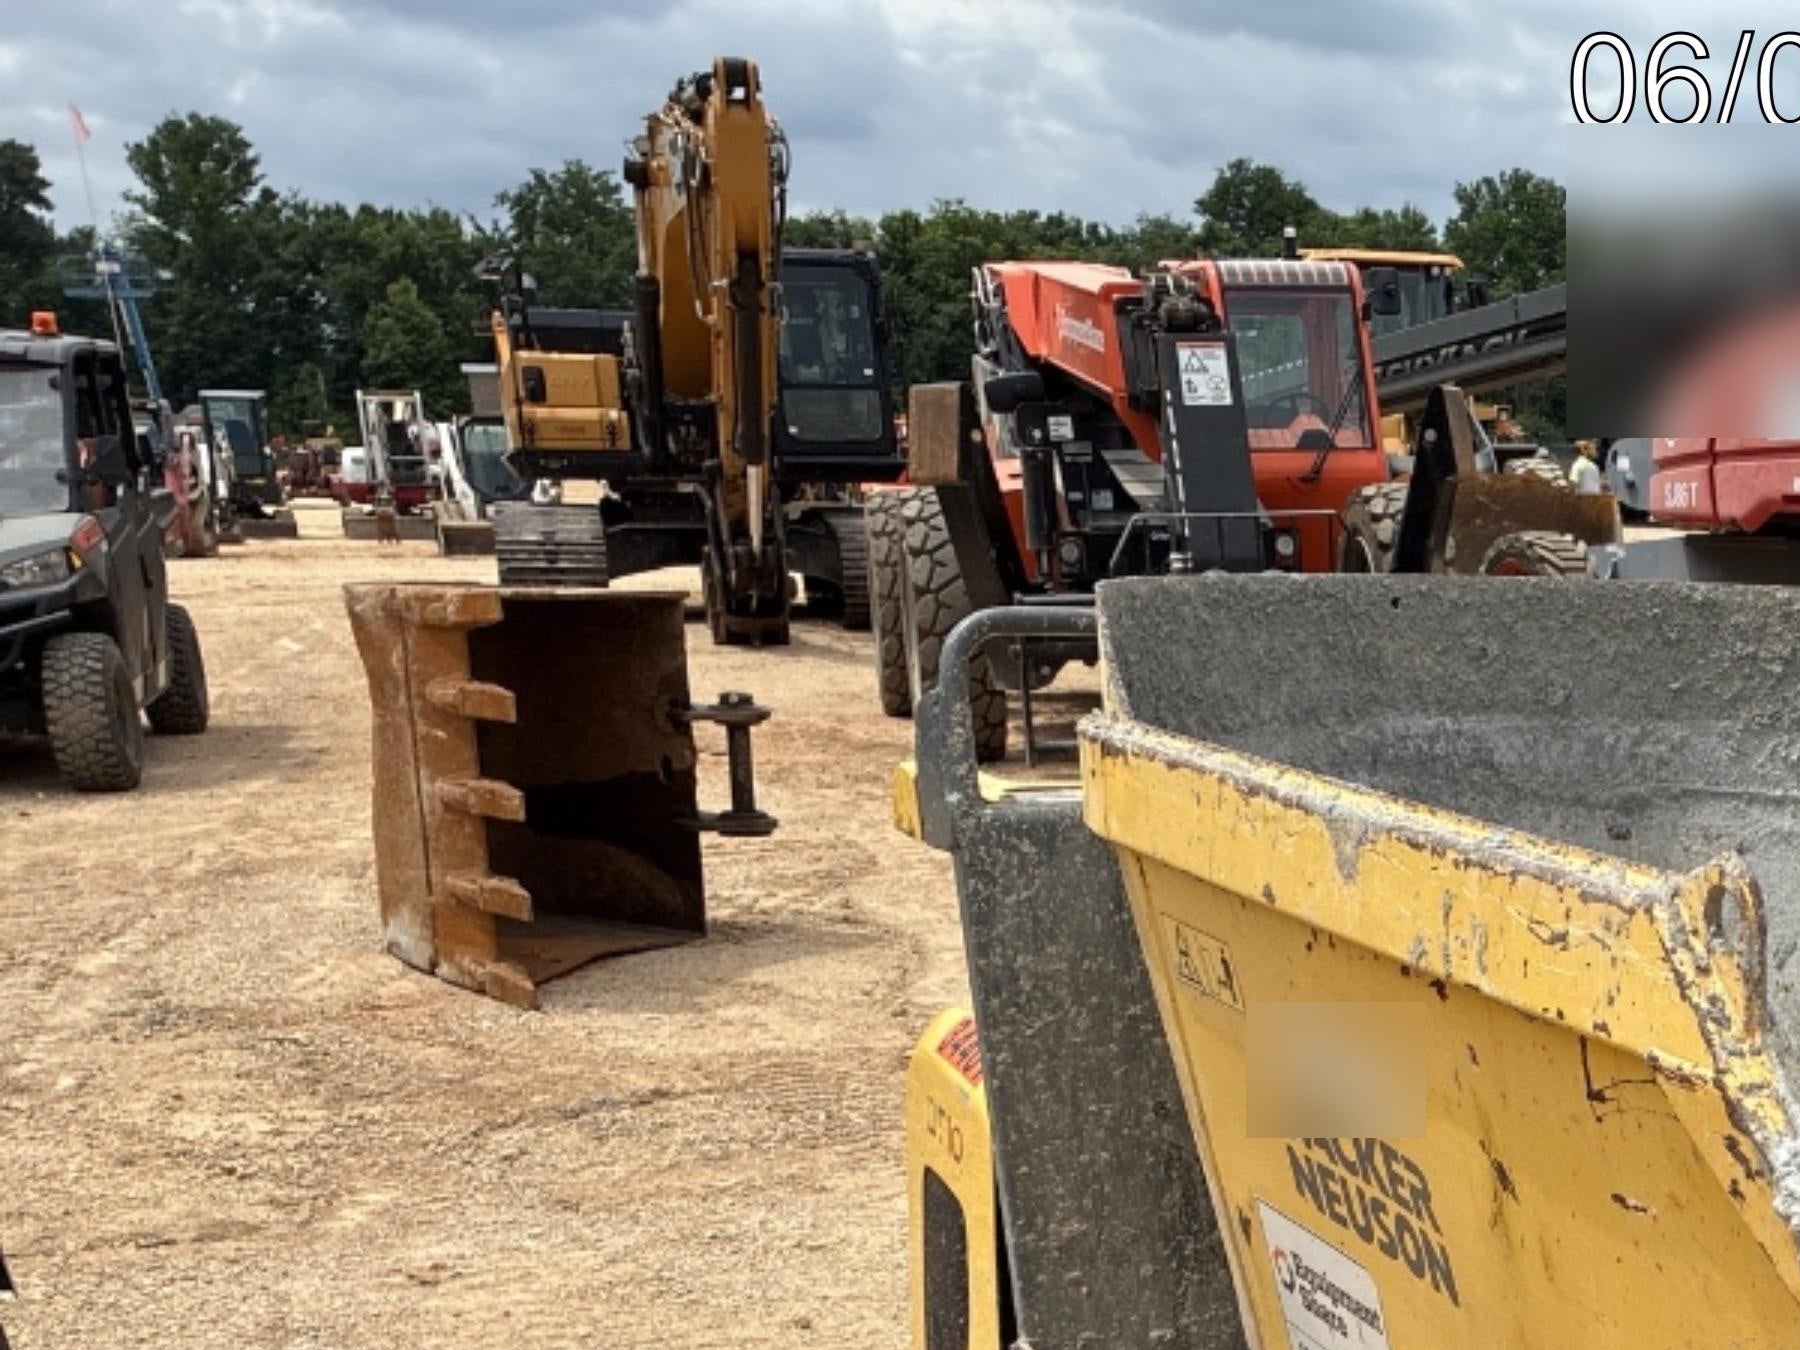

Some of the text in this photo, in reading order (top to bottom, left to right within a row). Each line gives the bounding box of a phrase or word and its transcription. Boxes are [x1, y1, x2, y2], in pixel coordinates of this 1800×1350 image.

[1286, 1143, 1460, 1308] NEUSON
[1291, 1138, 1444, 1236] ACKER
[1289, 1250, 1384, 1336] Equipment
